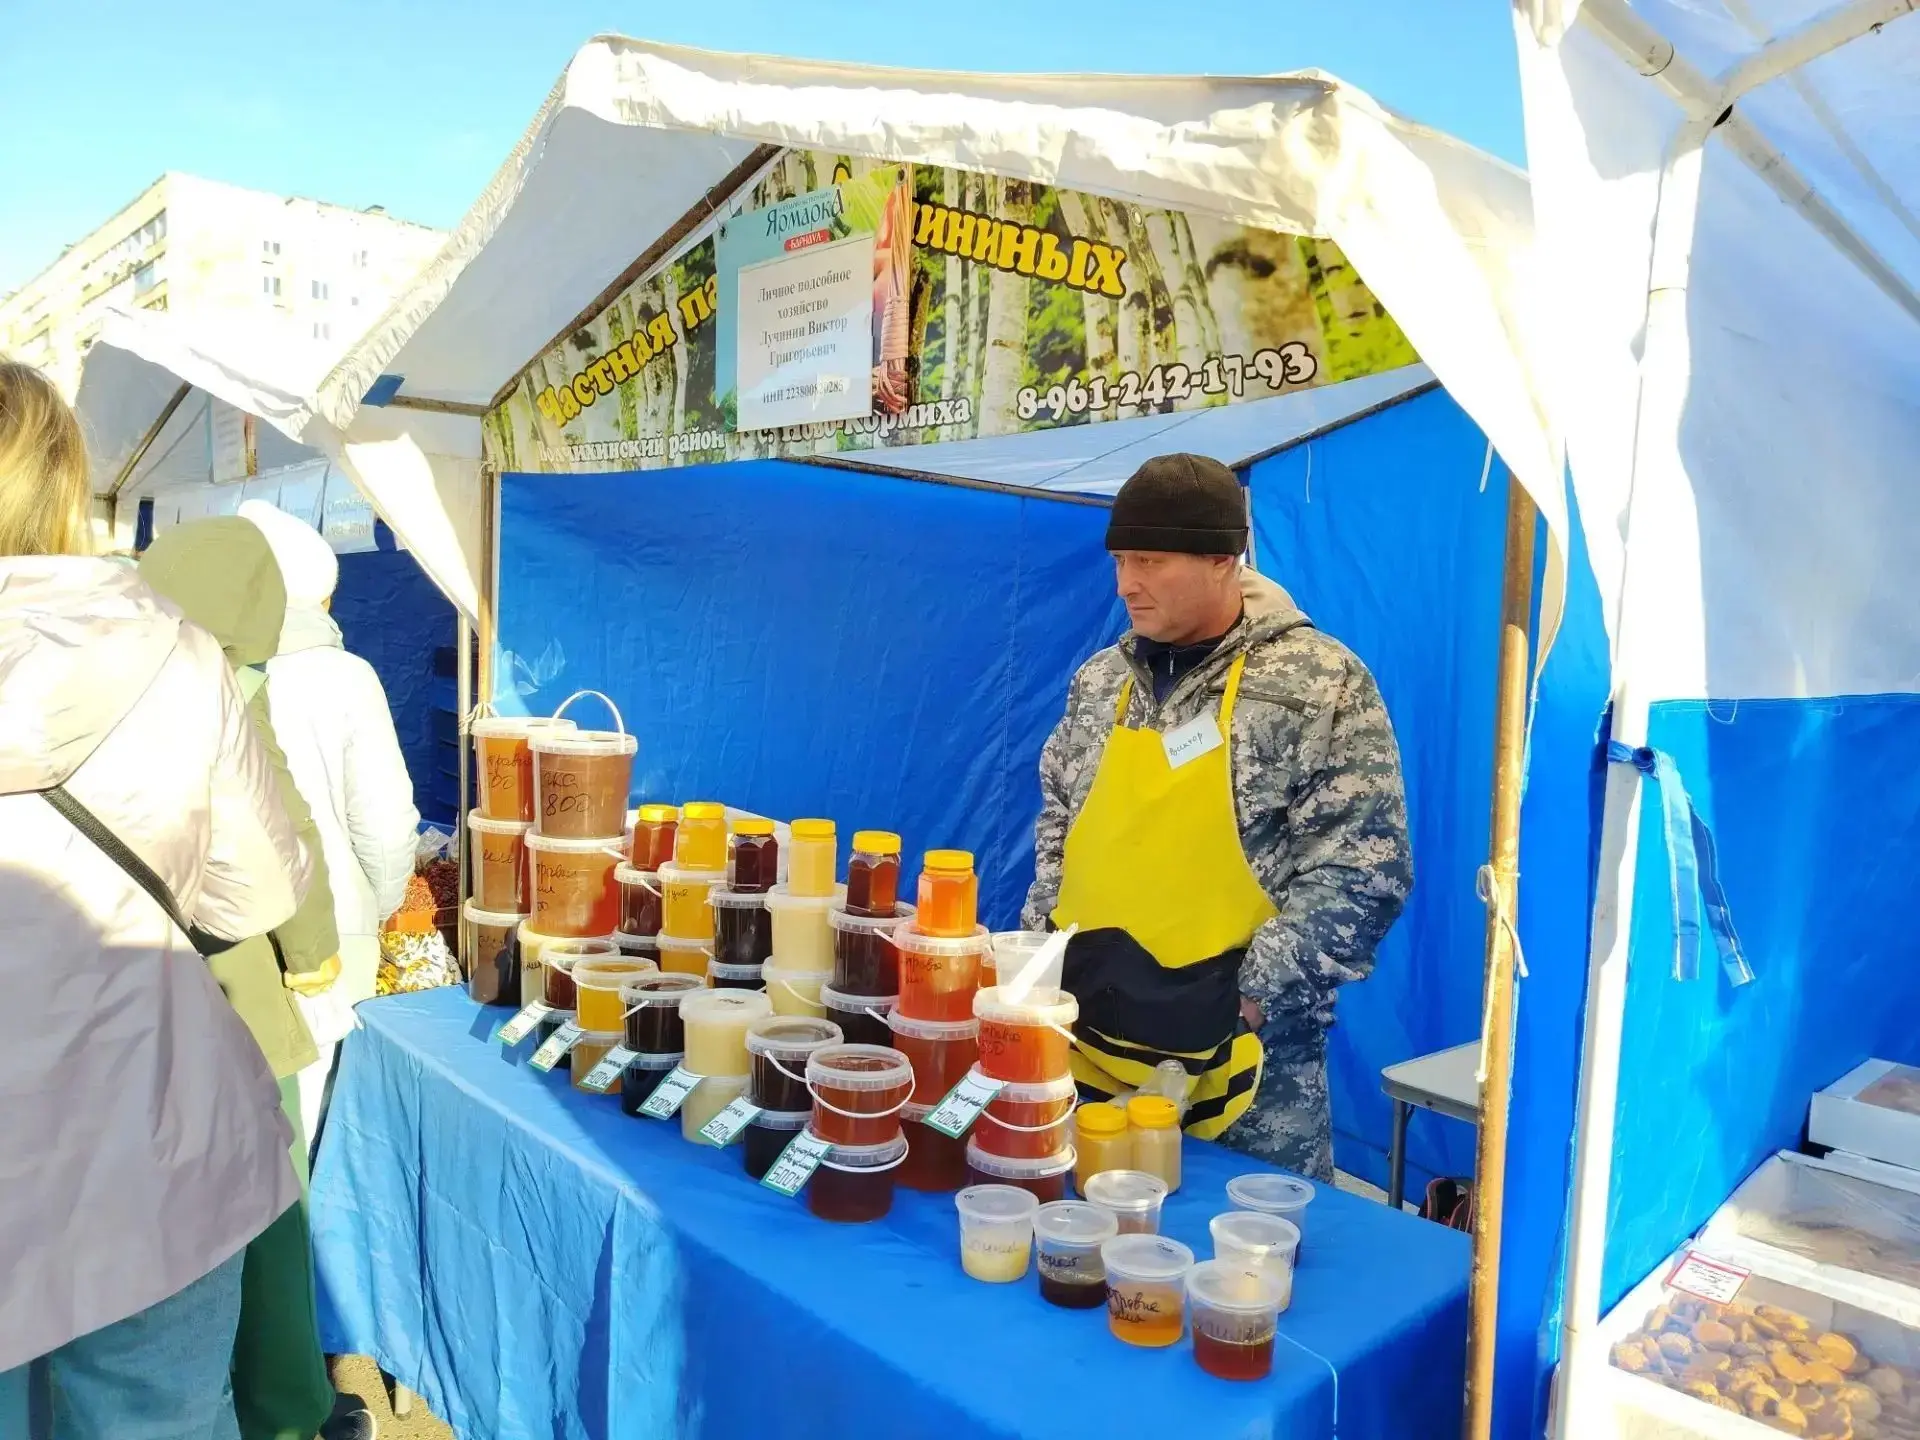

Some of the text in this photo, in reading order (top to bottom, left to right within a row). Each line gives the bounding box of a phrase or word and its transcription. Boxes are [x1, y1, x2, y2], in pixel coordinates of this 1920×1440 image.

[758, 268, 852, 303] Личное подсобное
[777, 298, 829, 320] хозяйство
[759, 317, 848, 348] Лучинин Виктор
[536, 311, 678, 428] Частная
[769, 342, 837, 368] Григорьевич
[763, 387, 784, 404] ИНН
[1016, 341, 1318, 422] 8-961-242-17-93
[668, 428, 726, 459] район
